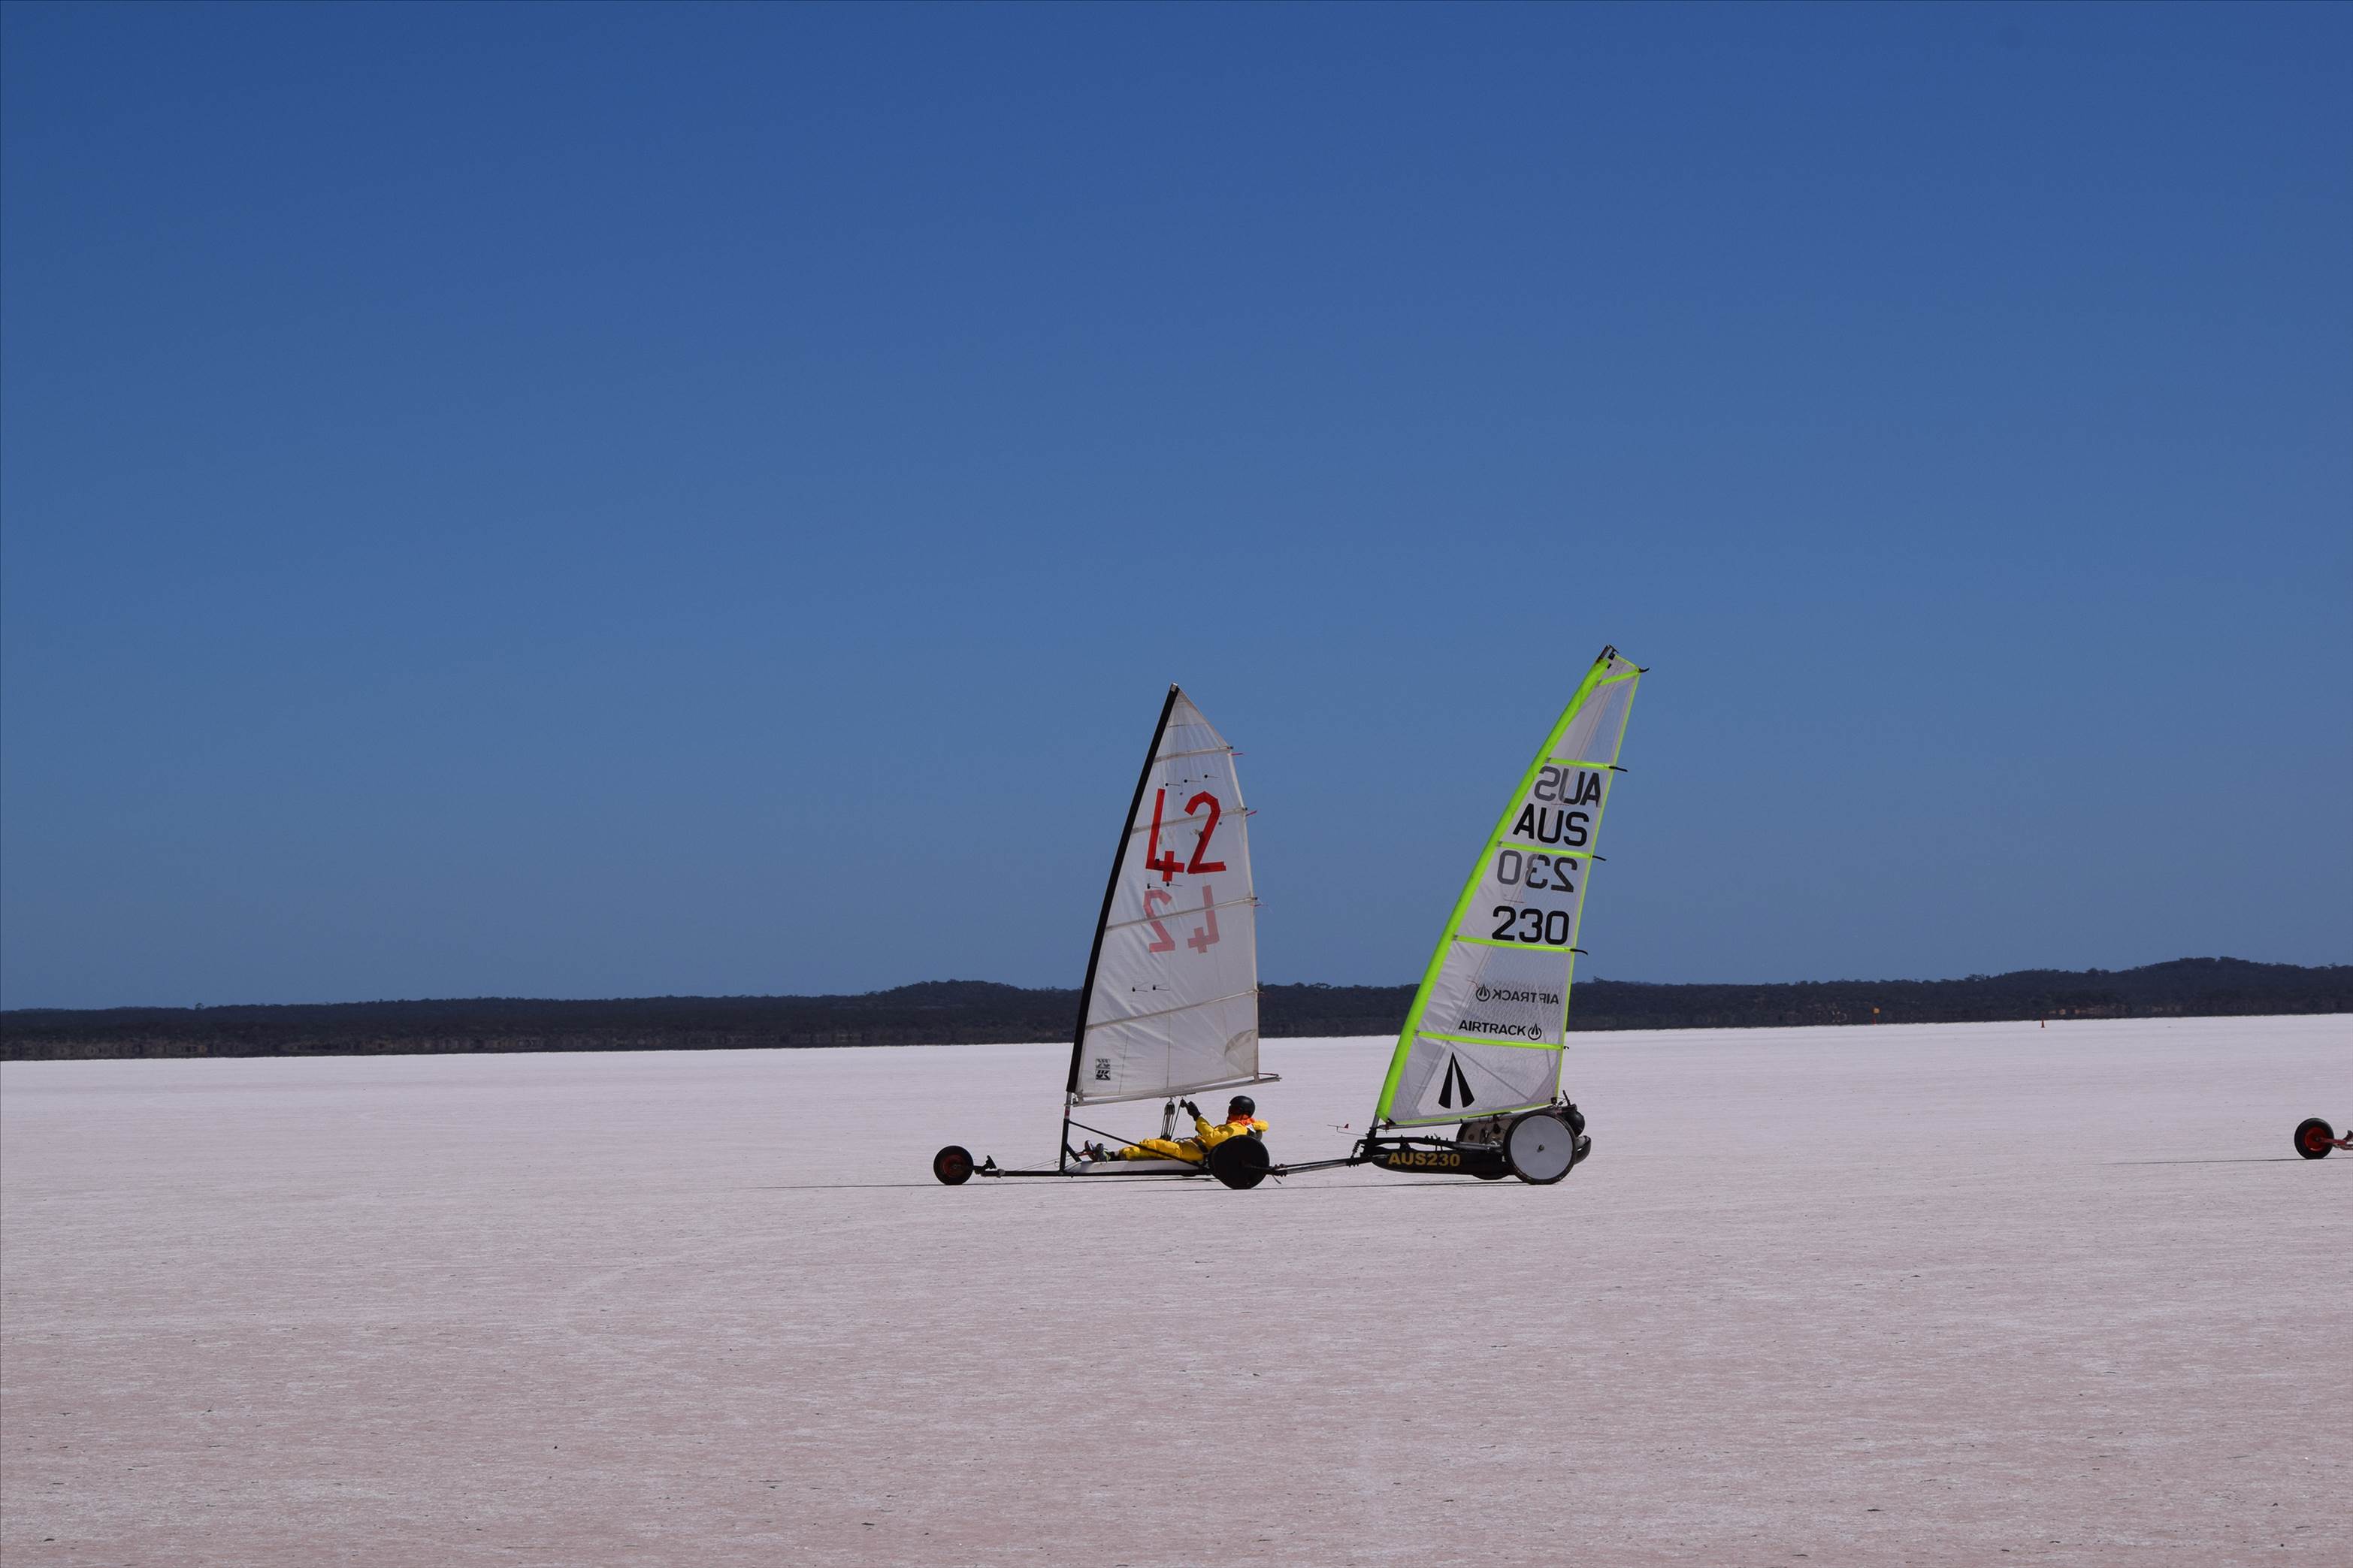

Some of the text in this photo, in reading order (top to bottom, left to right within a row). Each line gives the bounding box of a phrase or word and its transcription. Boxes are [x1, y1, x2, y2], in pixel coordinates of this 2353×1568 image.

[1145, 788, 1227, 882] 42
[1512, 803, 1589, 847] AUS
[1492, 905, 1570, 946] 230
[1458, 1020, 1526, 1036] AIRTRACK
[1388, 1152, 1461, 1167] AUS230
